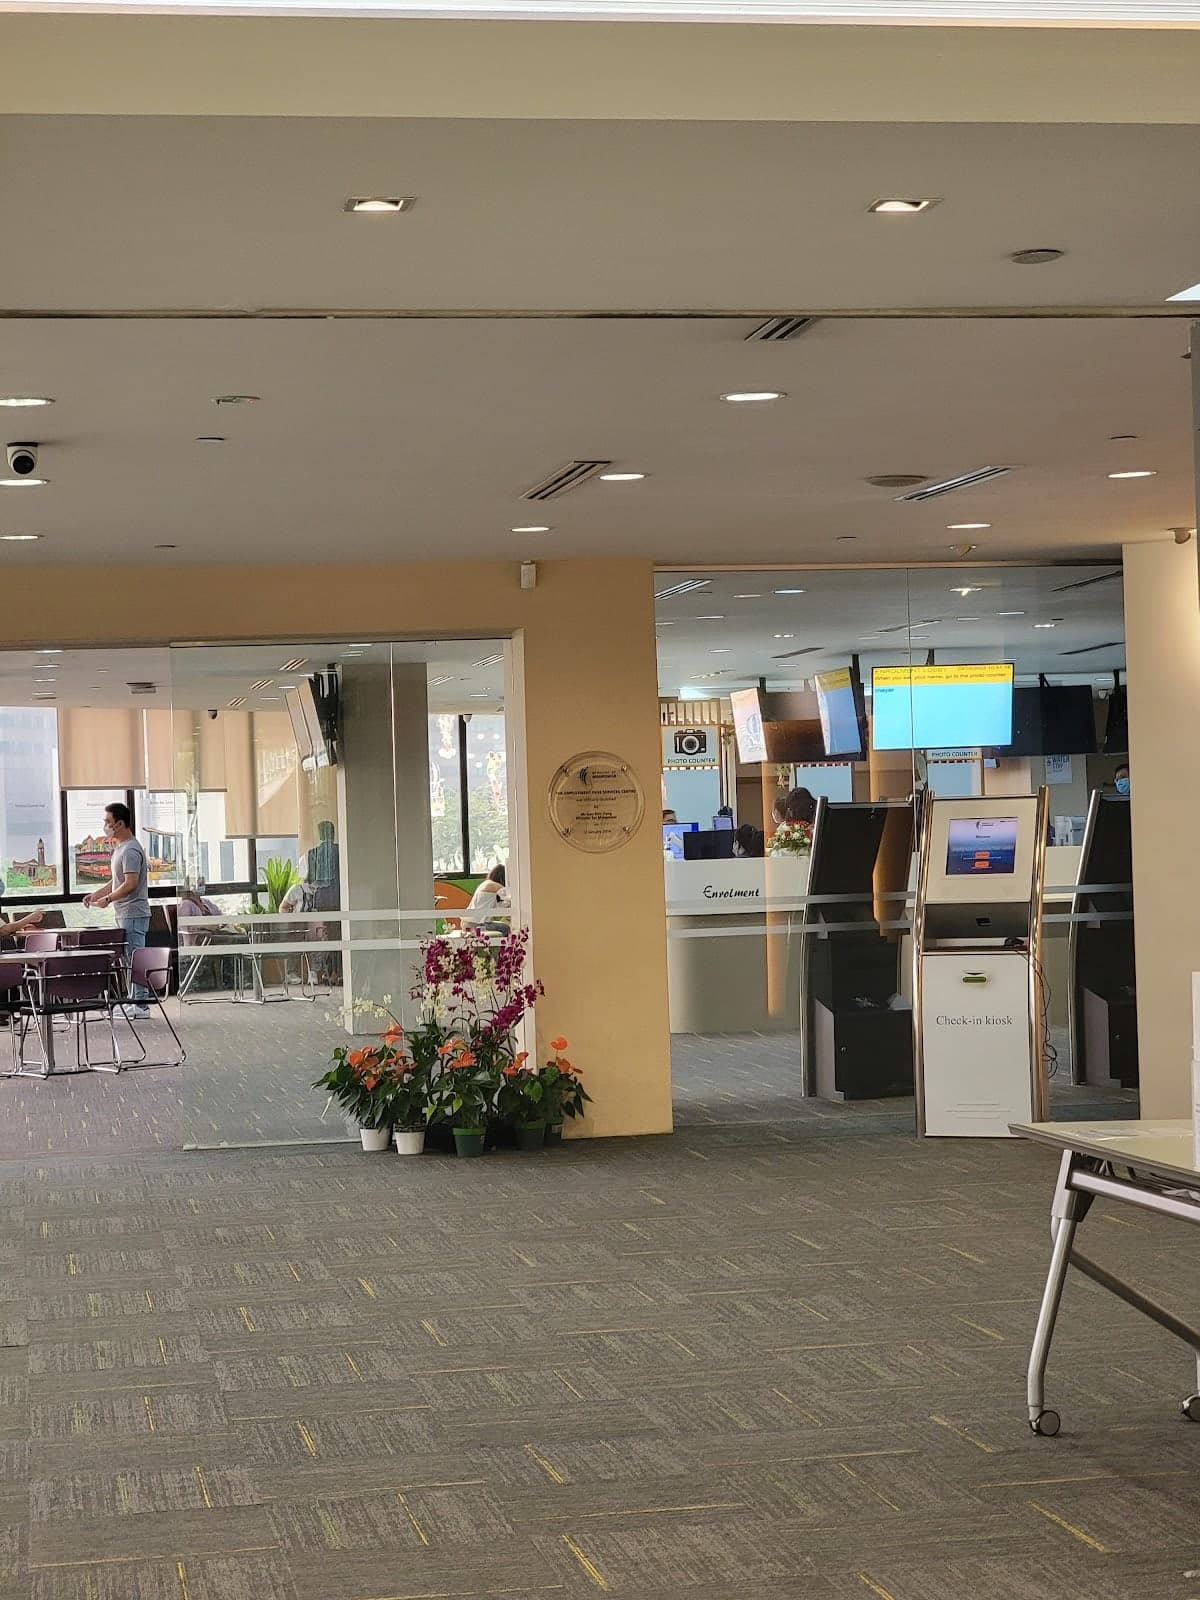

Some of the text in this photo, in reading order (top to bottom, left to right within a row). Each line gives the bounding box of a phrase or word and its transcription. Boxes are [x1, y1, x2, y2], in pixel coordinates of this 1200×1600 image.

[702, 885, 760, 899] Enrolment
[936, 1015, 1013, 1026] Check-in kiosk
